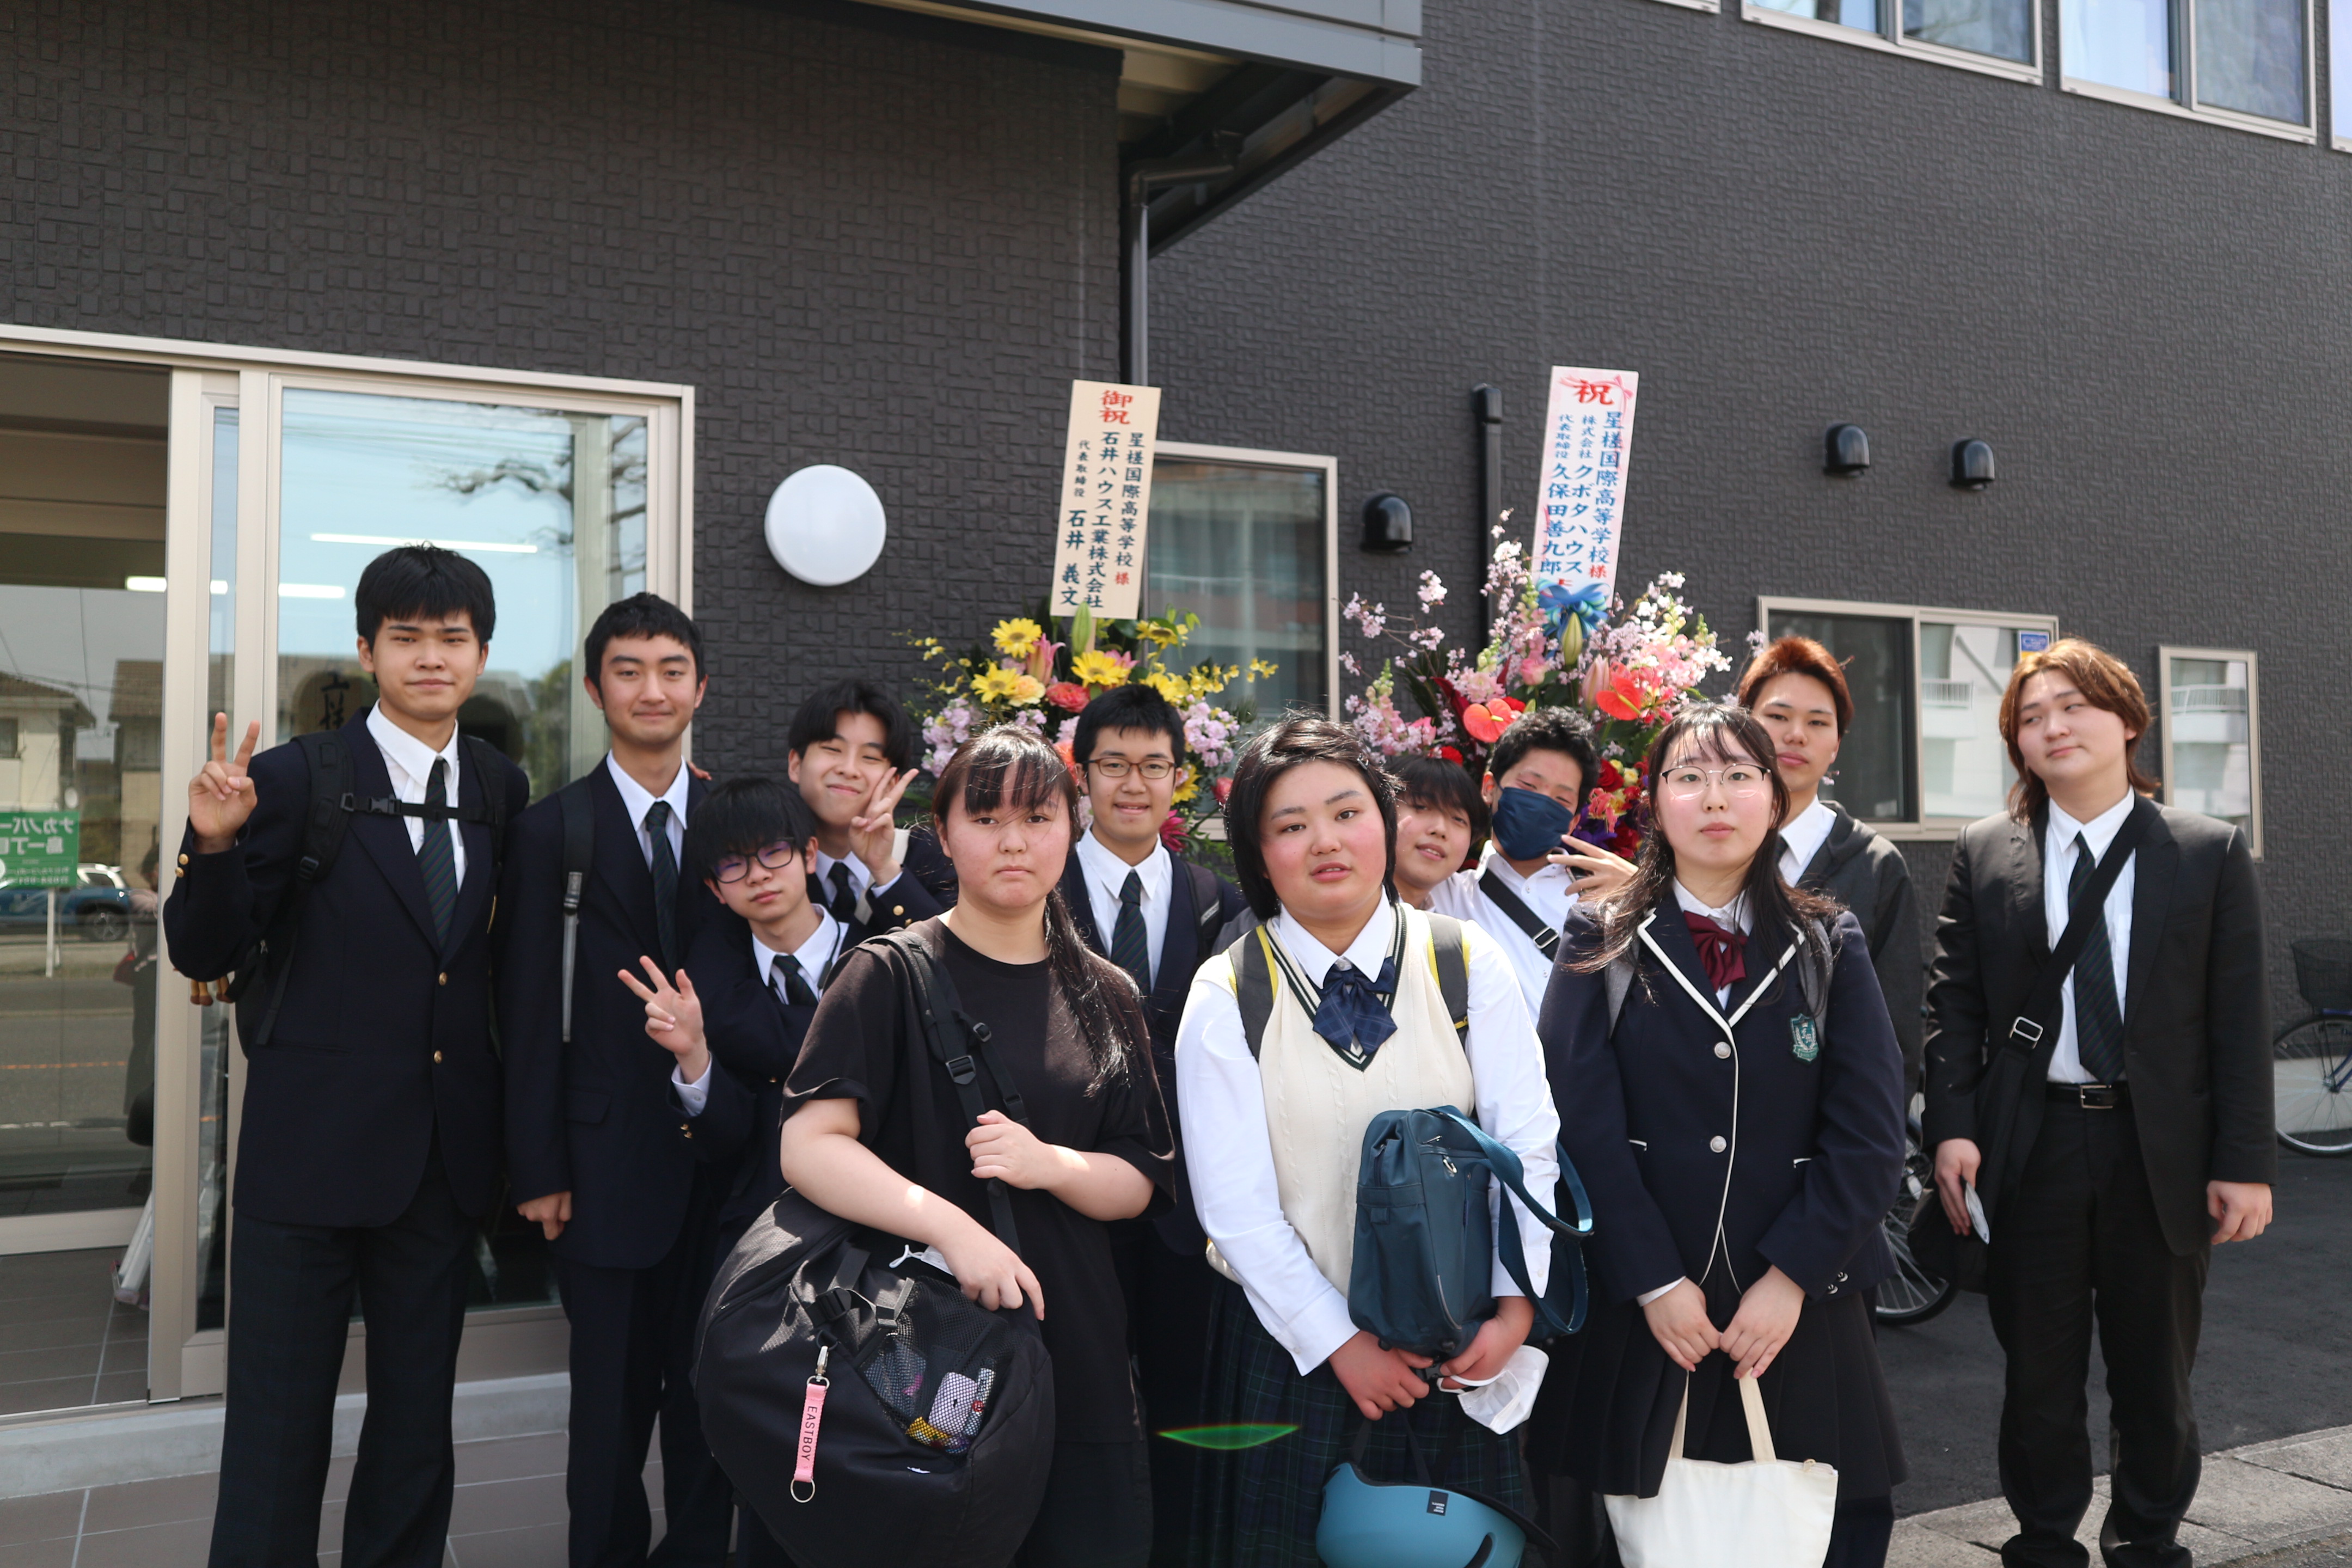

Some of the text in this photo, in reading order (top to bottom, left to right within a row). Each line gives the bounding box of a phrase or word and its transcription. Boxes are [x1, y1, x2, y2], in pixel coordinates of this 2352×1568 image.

[1099, 390, 1134, 424] 御祝
[1572, 378, 1615, 405] 祝
[1084, 431, 1121, 608] 石井ハウス工業株式会社
[801, 1406, 818, 1461] EASTBOY
